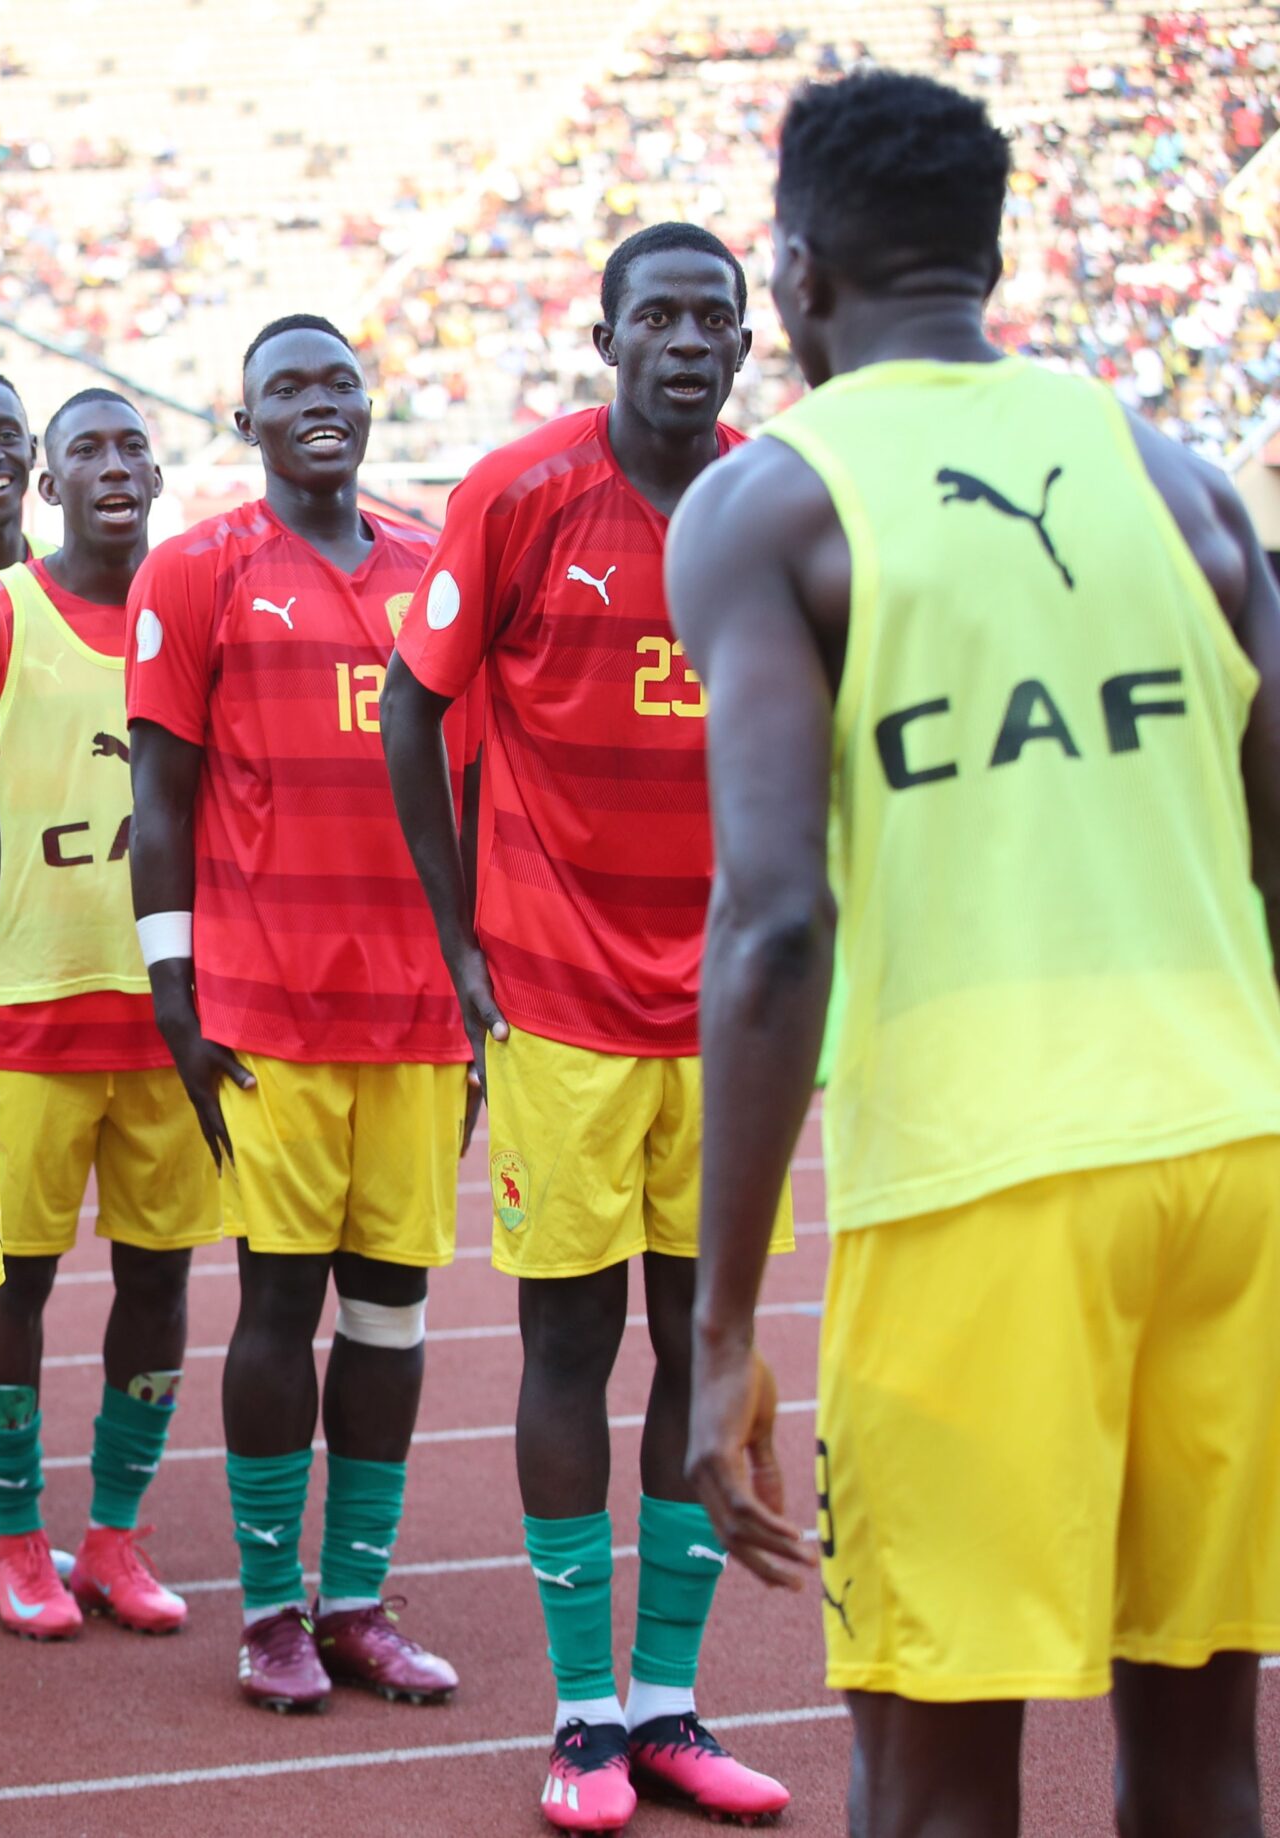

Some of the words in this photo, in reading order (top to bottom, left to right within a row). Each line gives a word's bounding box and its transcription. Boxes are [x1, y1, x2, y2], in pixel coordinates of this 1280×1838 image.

[335, 662, 387, 733] 12
[634, 635, 710, 717] 23
[874, 668, 1187, 792] CAF
